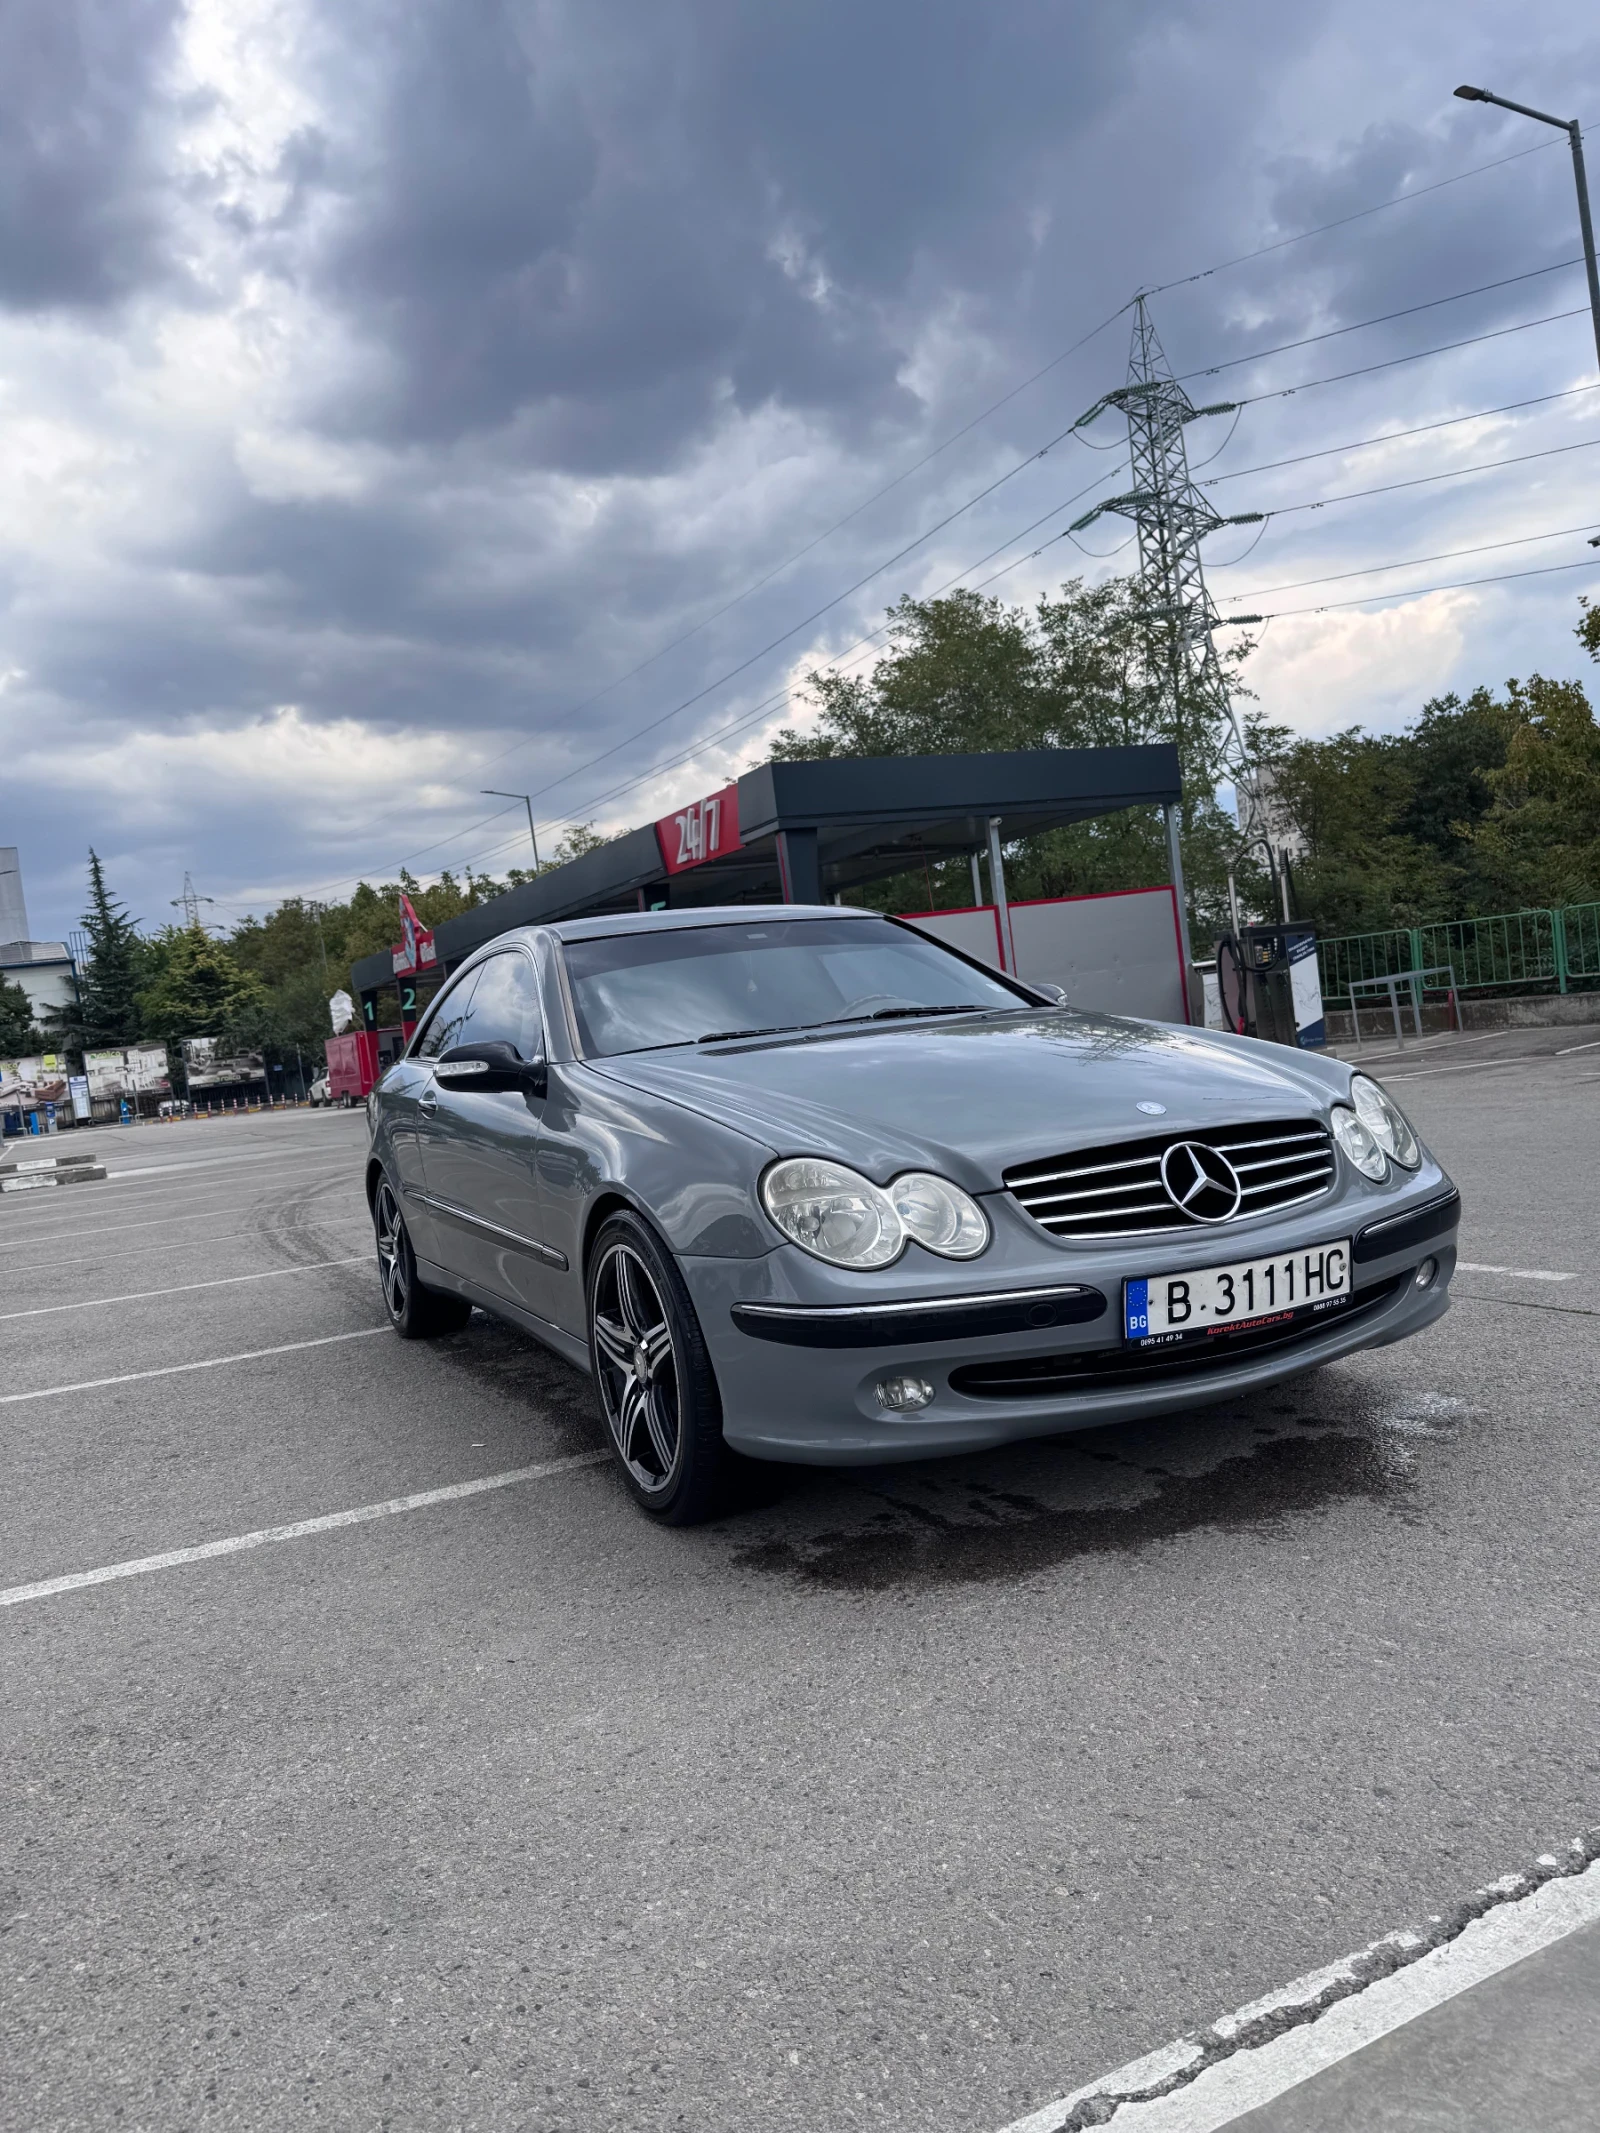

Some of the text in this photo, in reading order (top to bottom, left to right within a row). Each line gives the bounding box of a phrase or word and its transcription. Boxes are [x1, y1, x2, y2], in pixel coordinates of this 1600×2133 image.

[675, 798, 720, 864] 24/7
[402, 988, 417, 1010] 2
[364, 1001, 374, 1021] 1
[1129, 1315, 1147, 1330] BG
[1207, 1311, 1294, 1336] KorektAutoCars.bg
